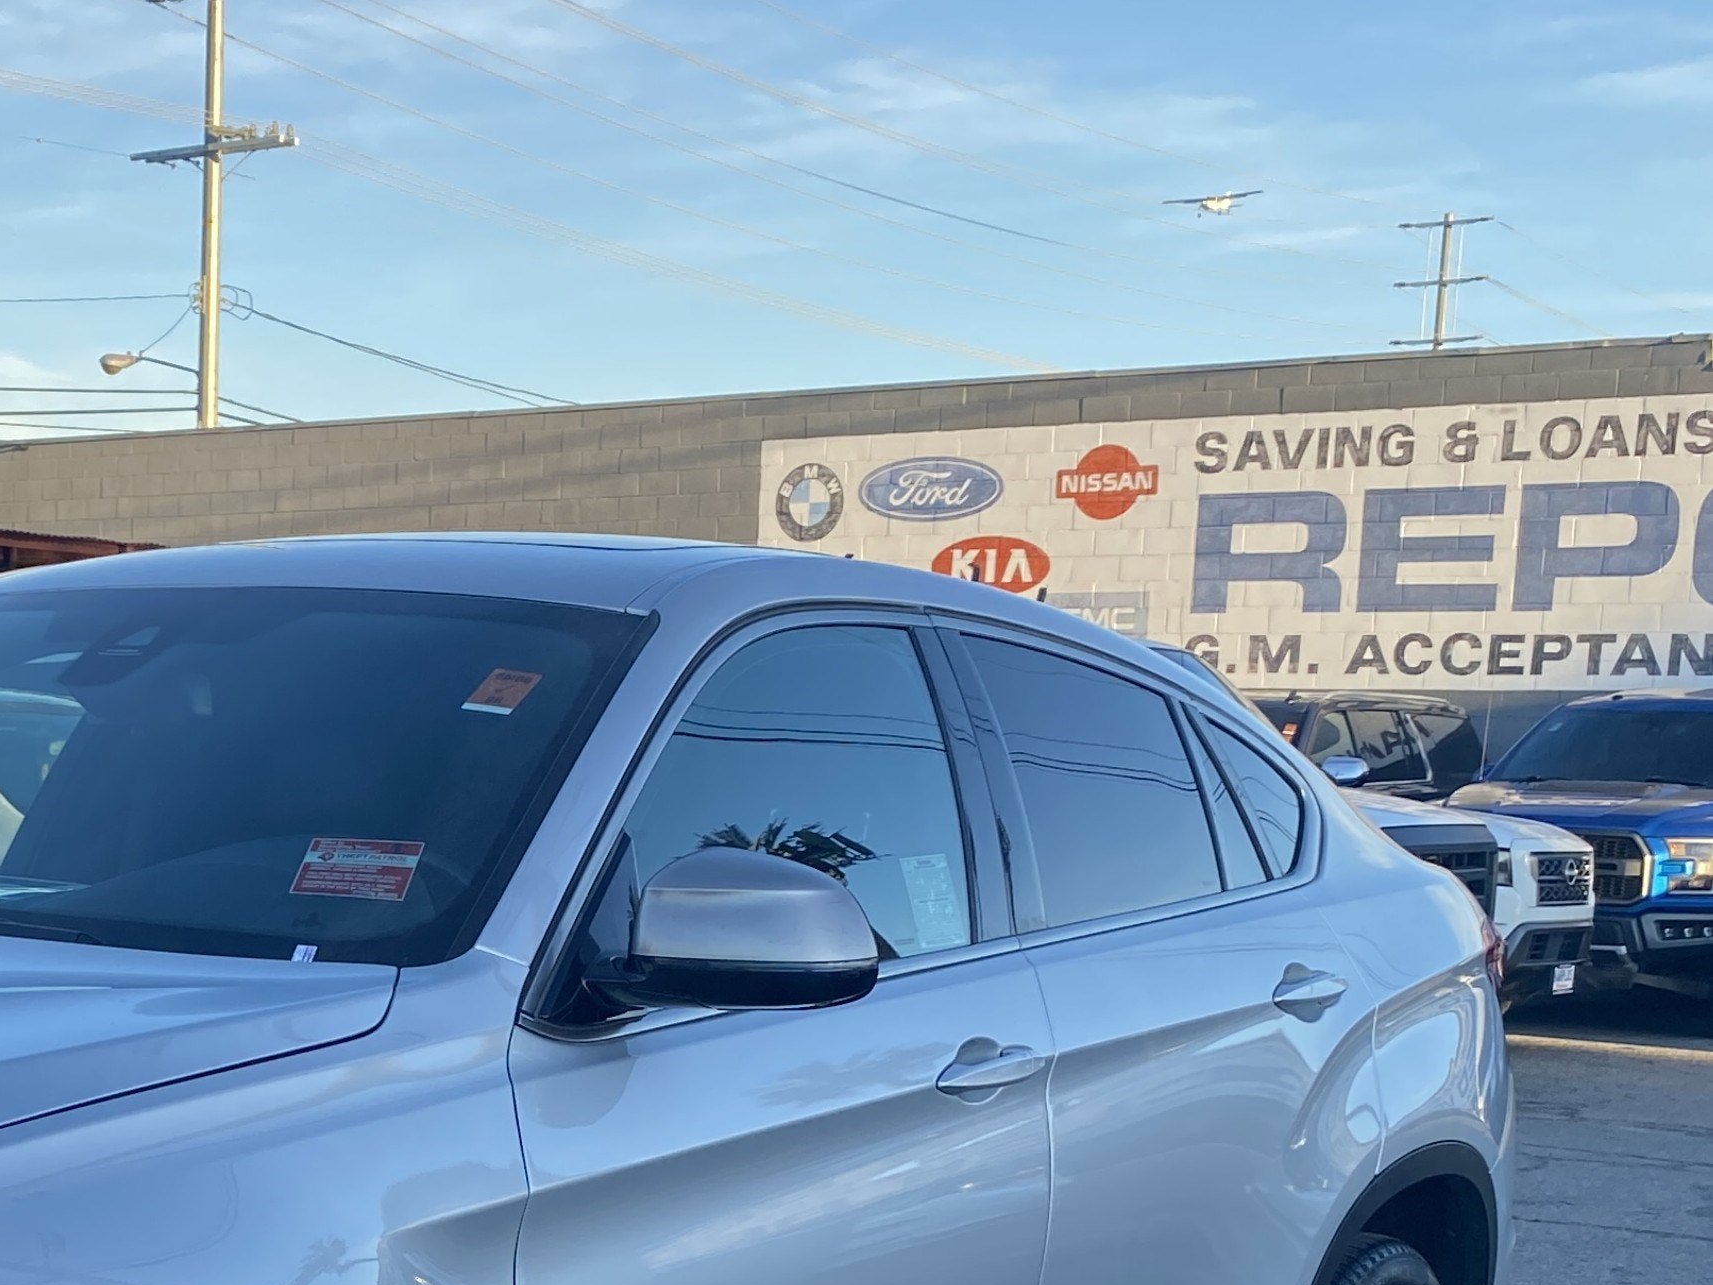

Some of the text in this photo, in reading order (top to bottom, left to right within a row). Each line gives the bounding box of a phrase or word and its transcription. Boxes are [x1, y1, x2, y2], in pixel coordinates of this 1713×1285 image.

[1194, 410, 1713, 474] SAVING & LOANS
[888, 470, 969, 508] Ford
[1060, 470, 1153, 494] NISSAN
[950, 548, 1033, 583] KIA
[1190, 480, 1713, 613] REP
[1061, 607, 1136, 630] MC
[1344, 632, 1713, 676] ACCEPTAN
